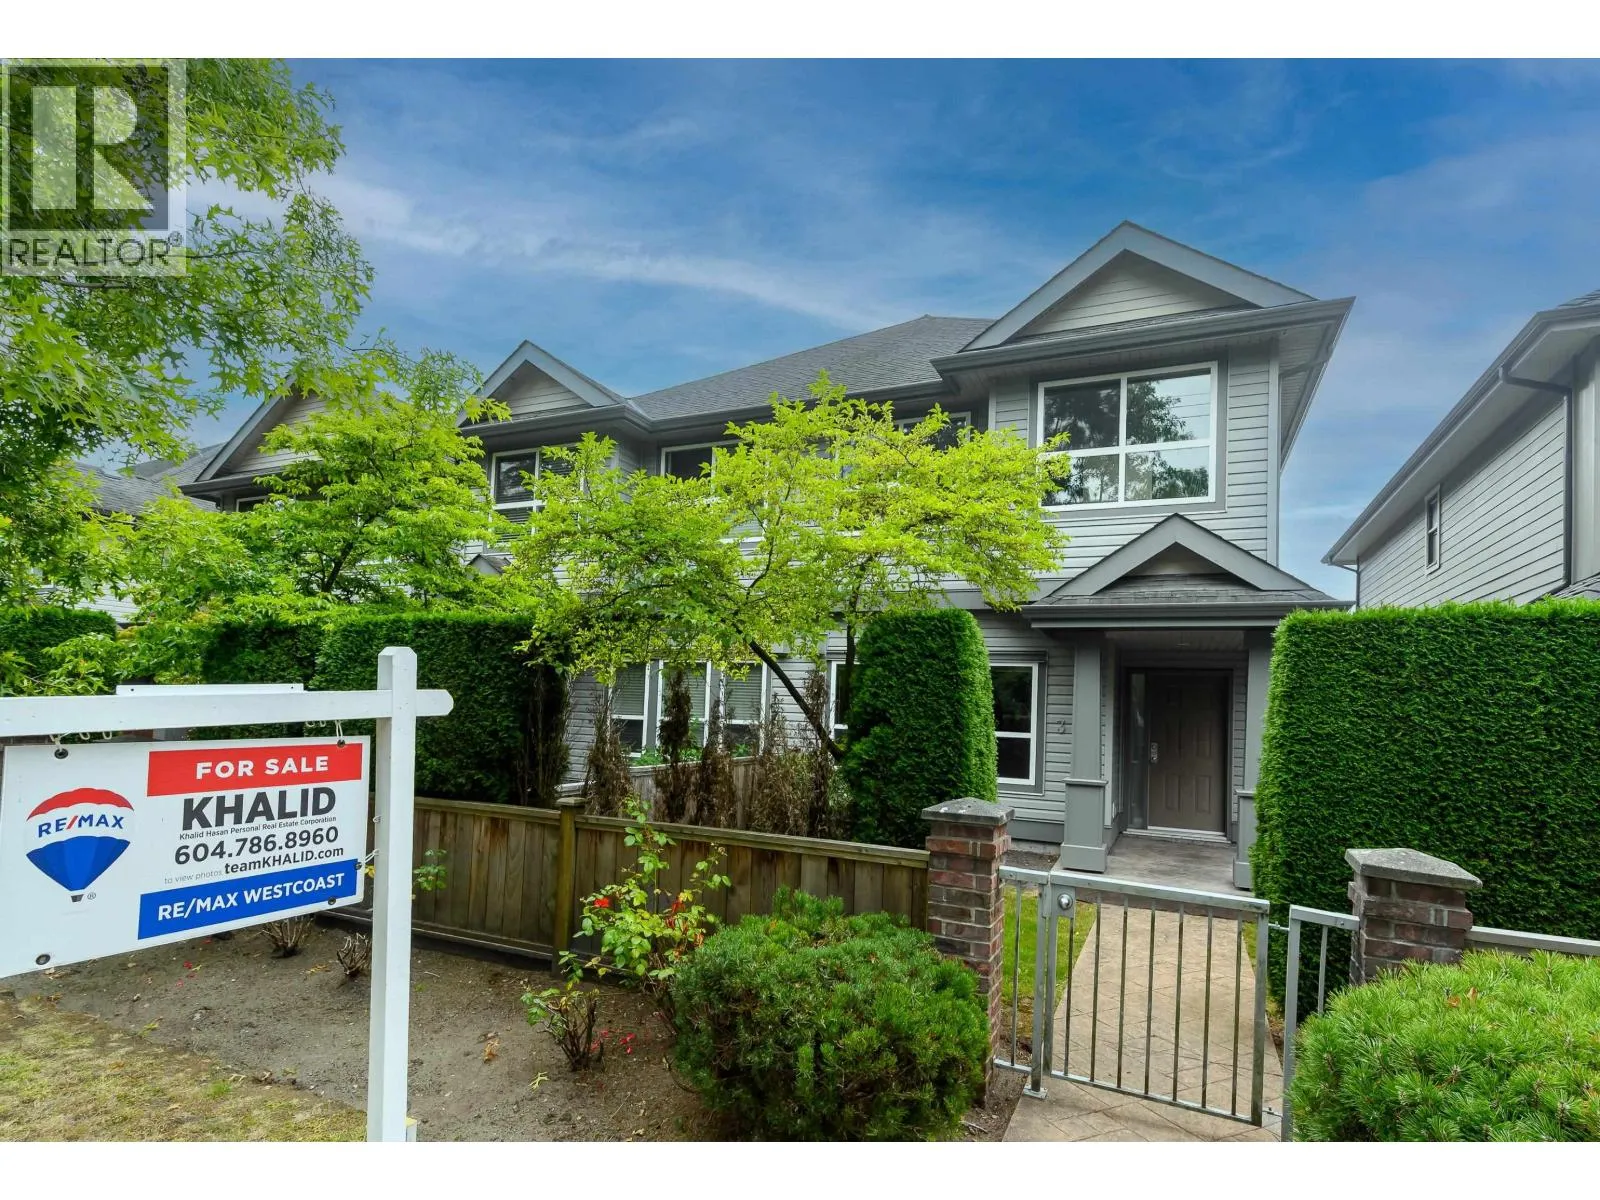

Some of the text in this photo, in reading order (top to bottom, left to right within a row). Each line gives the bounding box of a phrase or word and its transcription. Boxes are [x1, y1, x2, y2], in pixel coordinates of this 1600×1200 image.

[196, 756, 329, 780] FOR SALE
[38, 813, 125, 838] RE/MAX
[182, 786, 336, 831] KHALID
[174, 826, 339, 865] 604.786.8960
[179, 816, 337, 840] Khalid Hasan Personal Real Estate Corporation
[164, 847, 344, 884] to view photos teamKHALID.com
[157, 873, 345, 921] RE/MAX WESTCOAST
